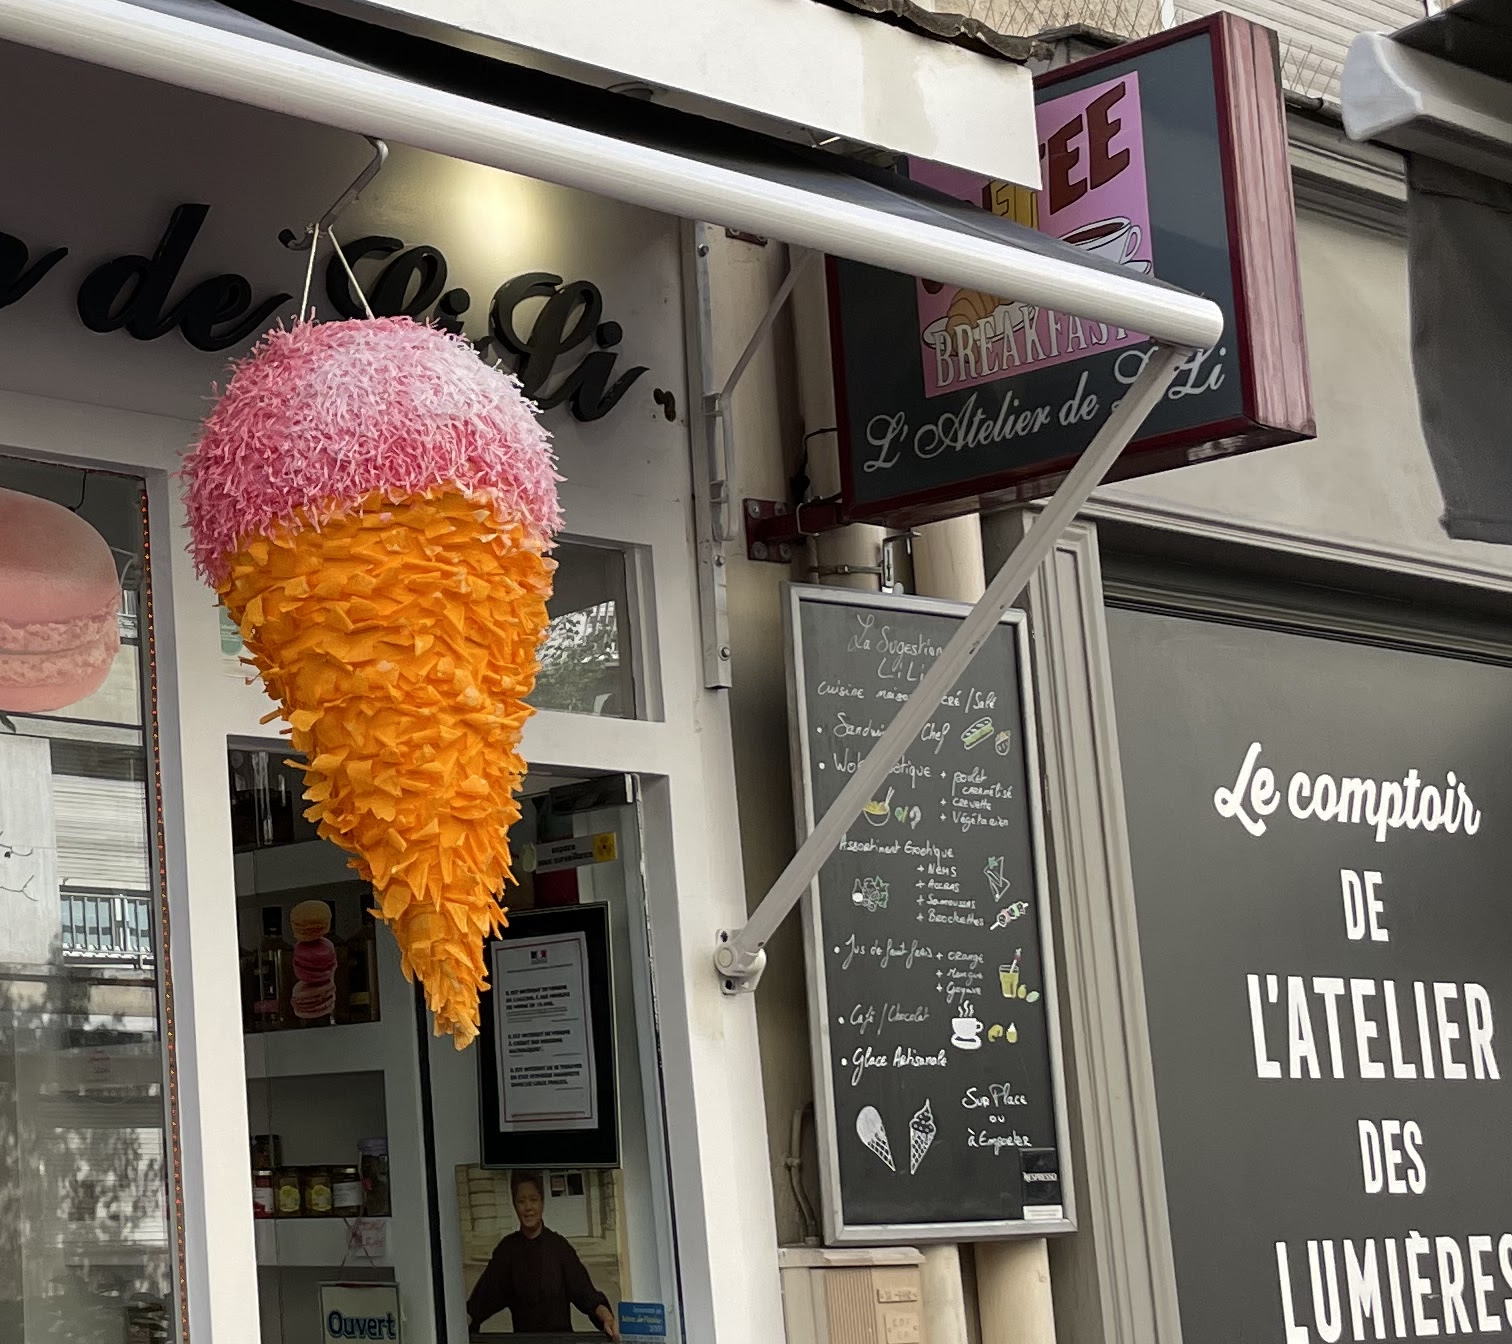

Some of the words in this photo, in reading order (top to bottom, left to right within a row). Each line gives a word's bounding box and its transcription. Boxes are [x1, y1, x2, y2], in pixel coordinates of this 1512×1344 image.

[76, 202, 294, 353] de
[863, 391, 1051, 473] L'Atelier
[1058, 370, 1100, 426] de
[1214, 741, 1280, 837] Le
[1288, 768, 1481, 843] comptoir
[1339, 868, 1389, 942] DE
[1246, 973, 1501, 1079] L'ATELIER
[1357, 1119, 1427, 1195] DES
[328, 1310, 396, 1340] Ouvert
